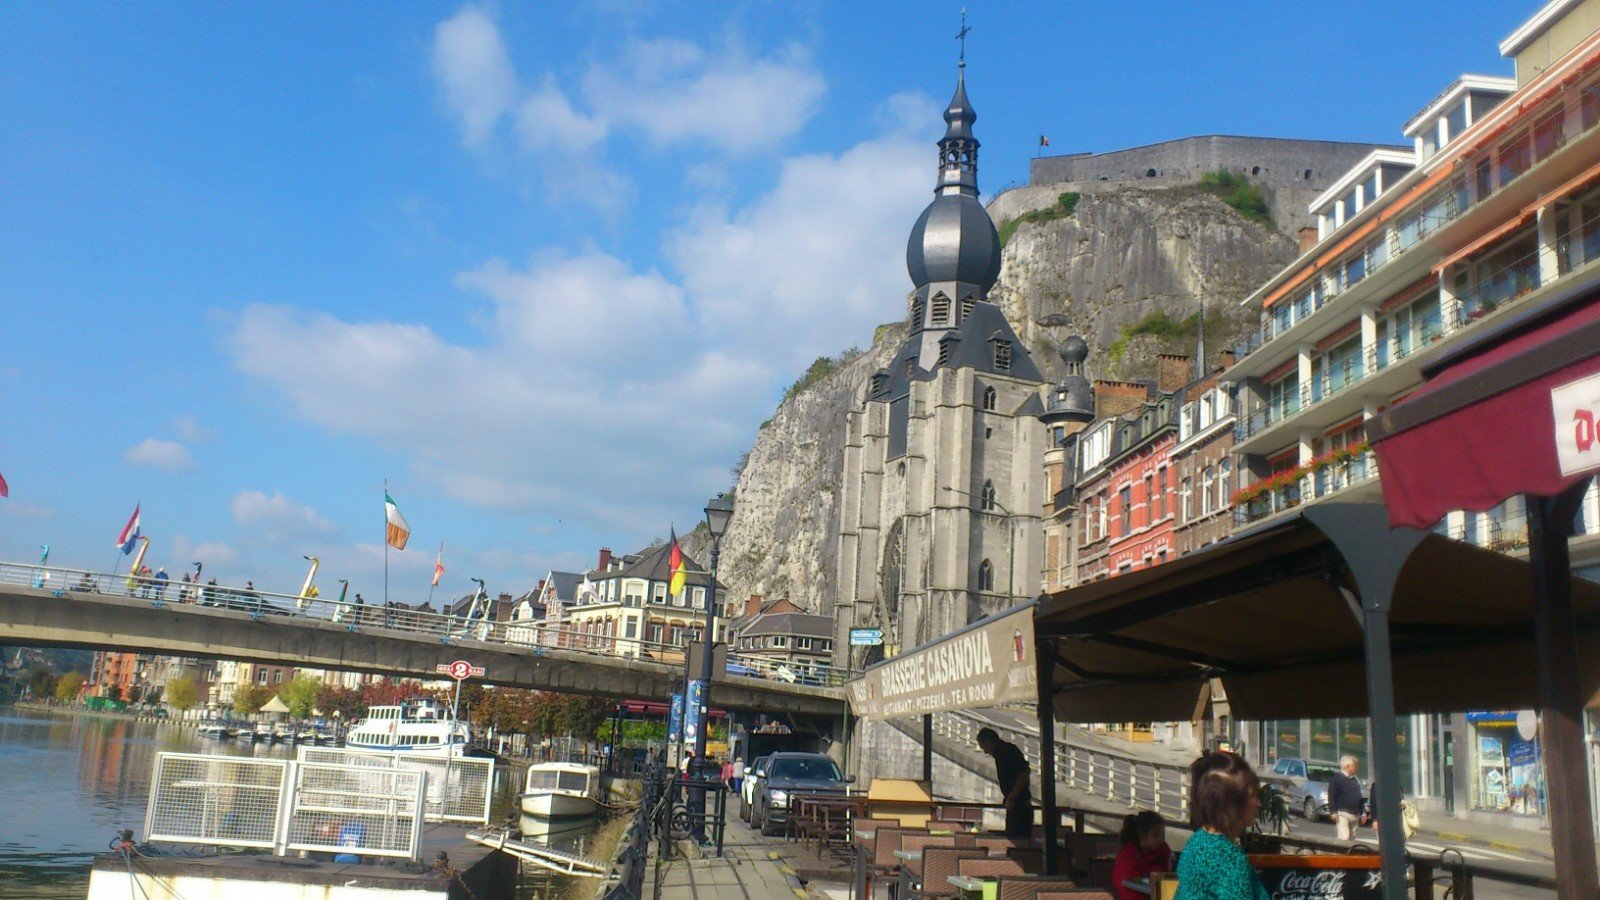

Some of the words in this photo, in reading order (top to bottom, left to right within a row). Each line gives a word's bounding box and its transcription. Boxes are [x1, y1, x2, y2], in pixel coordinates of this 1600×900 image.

[1573, 408, 1600, 454] D
[454, 663, 467, 677] 2
[881, 655, 926, 697] BRASSERIE
[927, 631, 994, 687] CASANOVA
[916, 692, 946, 711] PIZZERIA
[951, 688, 967, 705] TEA
[968, 682, 995, 701] ROOM
